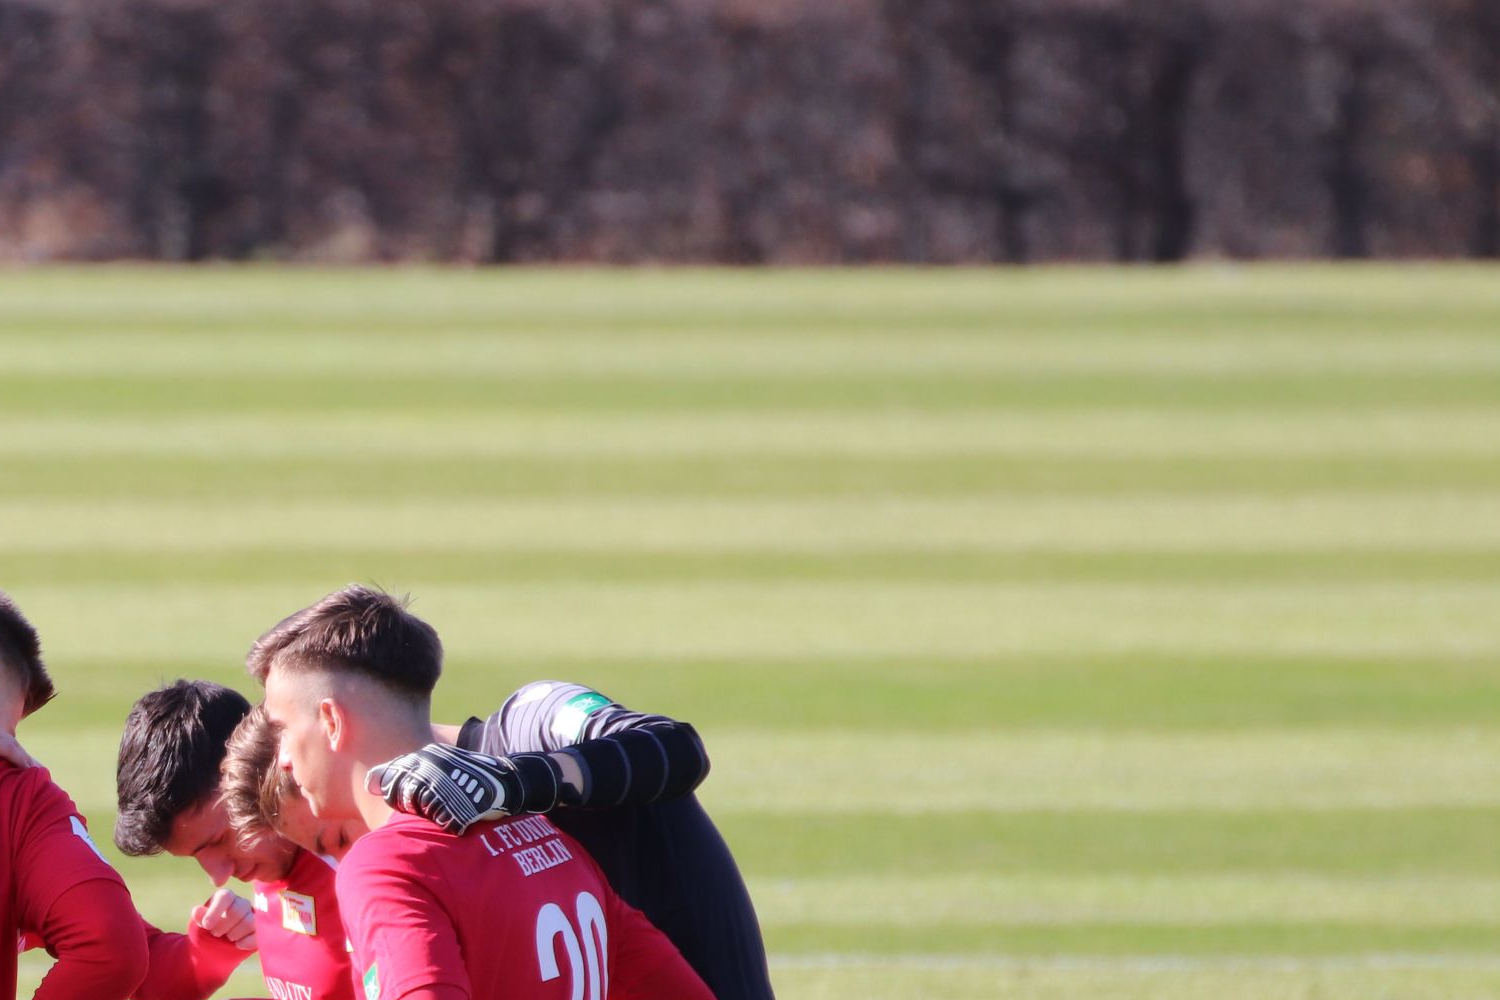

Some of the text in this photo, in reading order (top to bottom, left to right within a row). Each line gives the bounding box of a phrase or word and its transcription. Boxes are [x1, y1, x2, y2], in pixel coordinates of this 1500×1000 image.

[480, 834, 505, 857] 1.
[493, 824, 522, 849] FC
[512, 838, 573, 877] BERLIN
